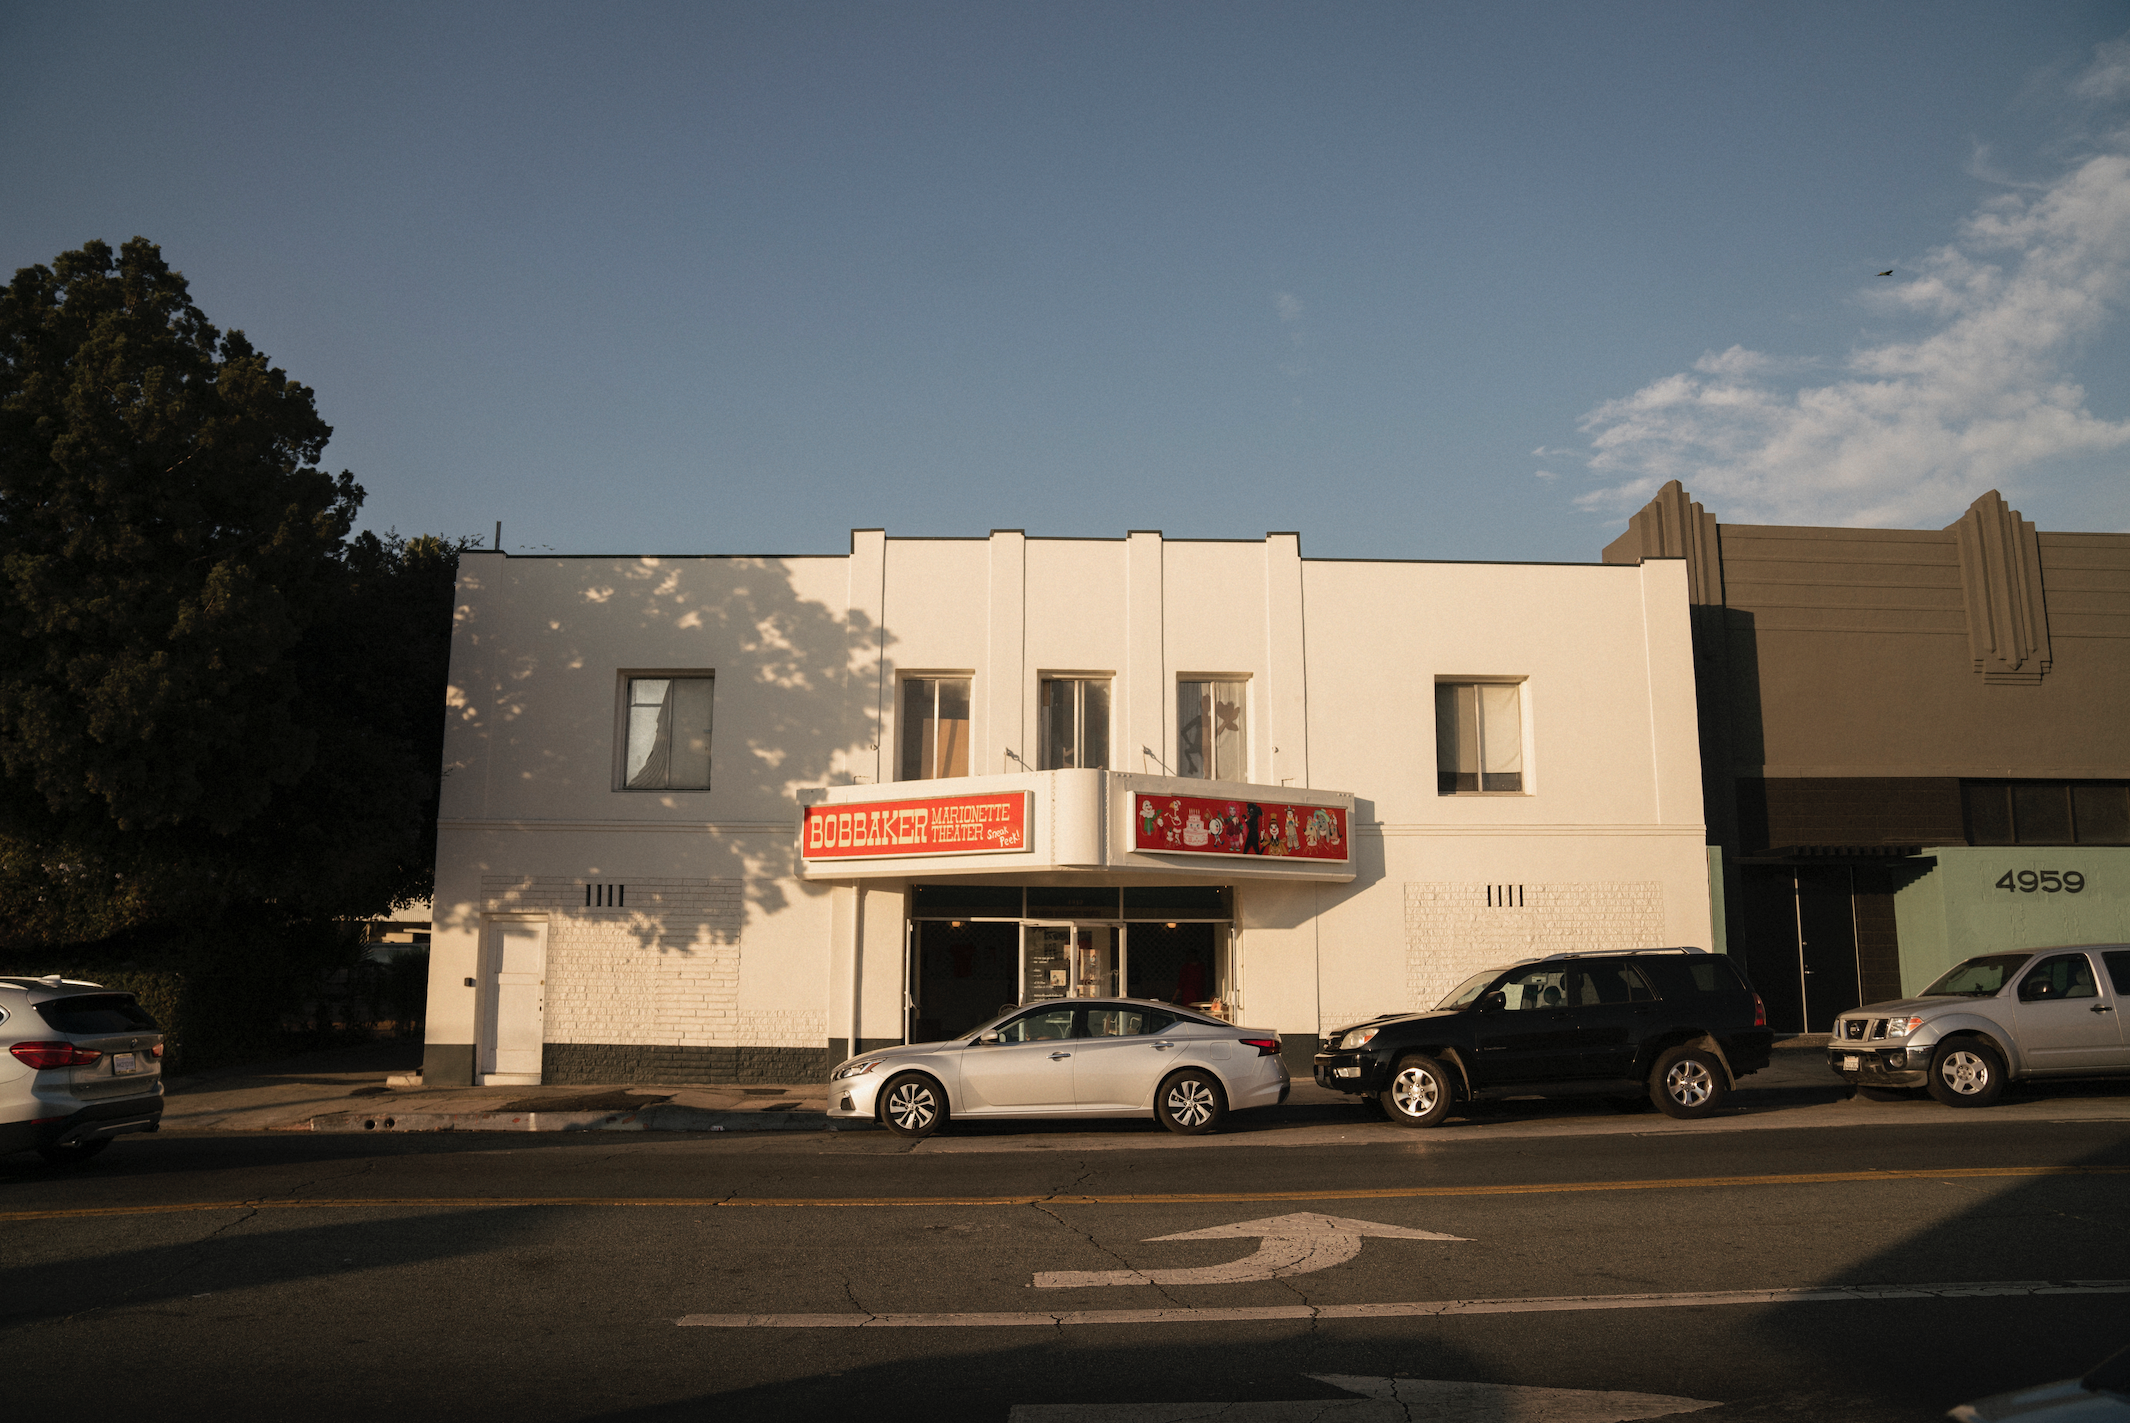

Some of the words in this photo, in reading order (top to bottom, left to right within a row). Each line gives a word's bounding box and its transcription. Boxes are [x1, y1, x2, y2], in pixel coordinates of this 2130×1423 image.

[931, 803, 1010, 825] MARIONETTE
[931, 823, 984, 843] THEATER
[987, 826, 1009, 841] Sneak
[999, 829, 1021, 848] Peek!
[1995, 869, 2085, 893] 4959
